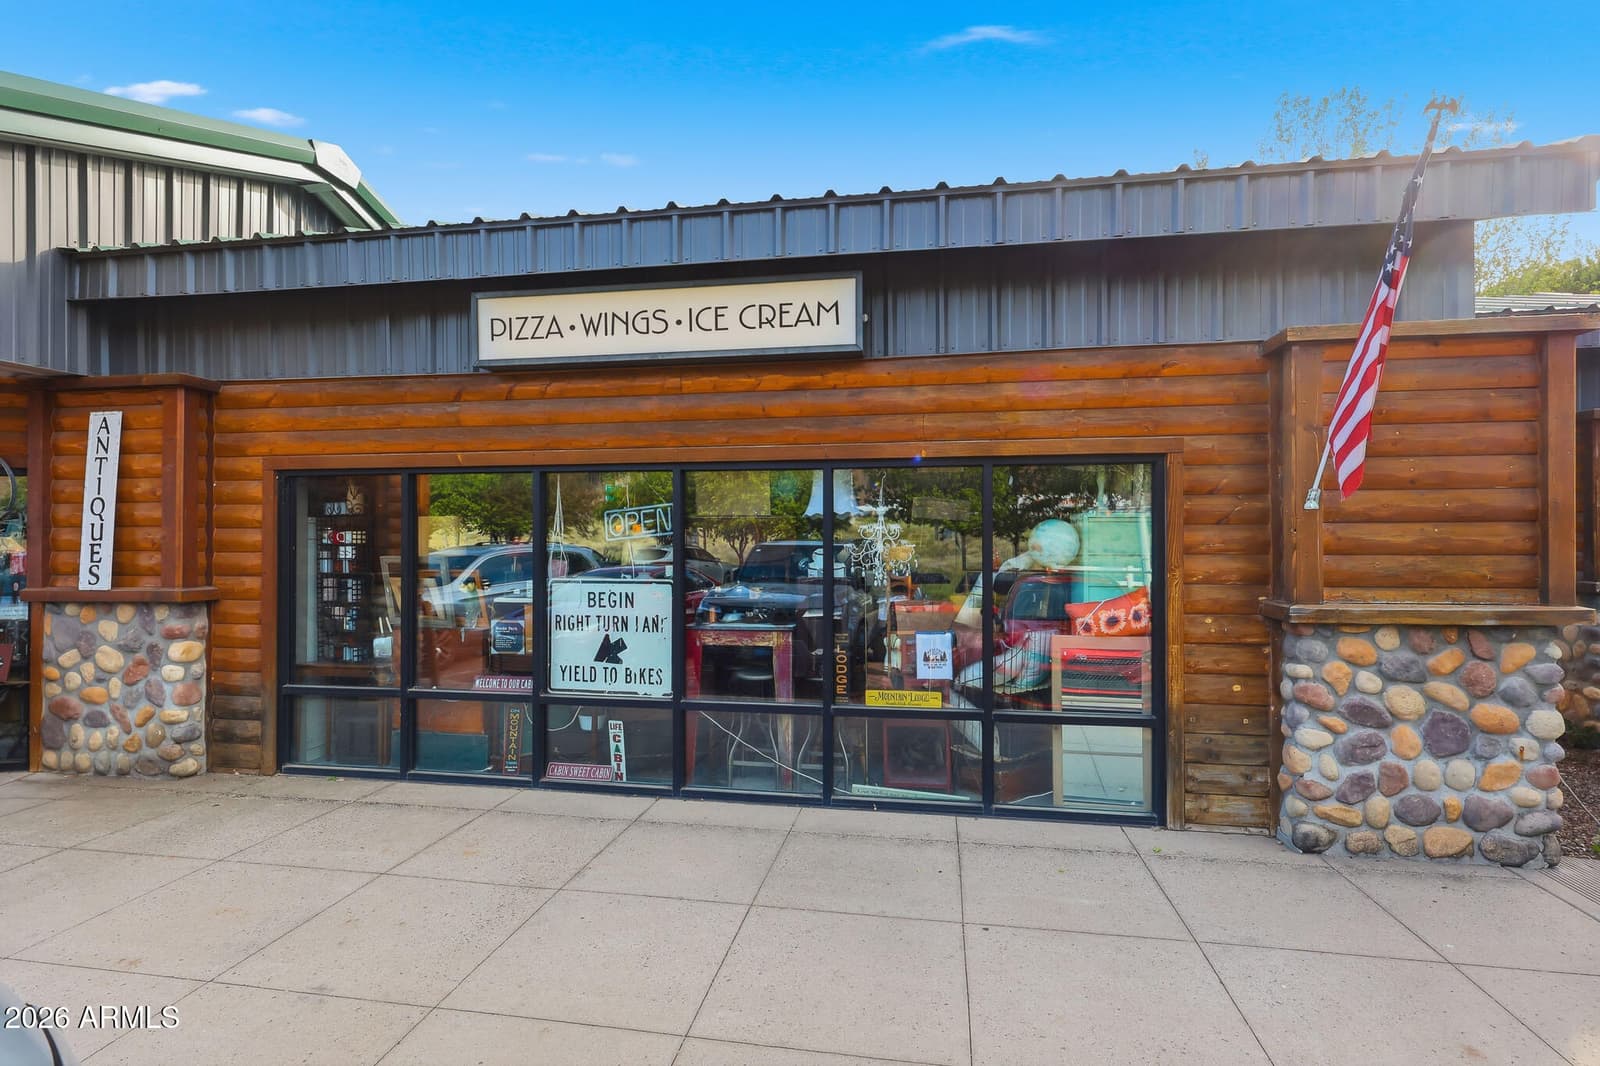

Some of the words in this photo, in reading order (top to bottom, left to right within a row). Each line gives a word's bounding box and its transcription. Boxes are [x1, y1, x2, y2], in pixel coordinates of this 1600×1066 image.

[490, 314, 564, 342] PIZZA
[580, 309, 669, 338] WINGS
[688, 306, 729, 332] ICE
[738, 300, 840, 329] CREAM
[88, 416, 109, 586] ANTIQUES
[608, 507, 672, 537] OPEN
[587, 591, 635, 608] BEGIN
[554, 614, 591, 631] RIGHT
[596, 615, 629, 632] TURN
[559, 665, 597, 683] YIELD
[602, 666, 618, 685] TO
[625, 667, 663, 686] BIKES
[835, 644, 848, 694] LODGE
[475, 678, 500, 689] WELCOME
[501, 678, 508, 689] TO
[508, 679, 520, 689] OUR
[508, 713, 519, 761] MOUNTAIN
[609, 722, 622, 731] LIFE
[613, 734, 624, 781] CABIN
[549, 764, 568, 777] CABIN
[569, 766, 590, 778] SWEET
[590, 767, 611, 779] CABIN
